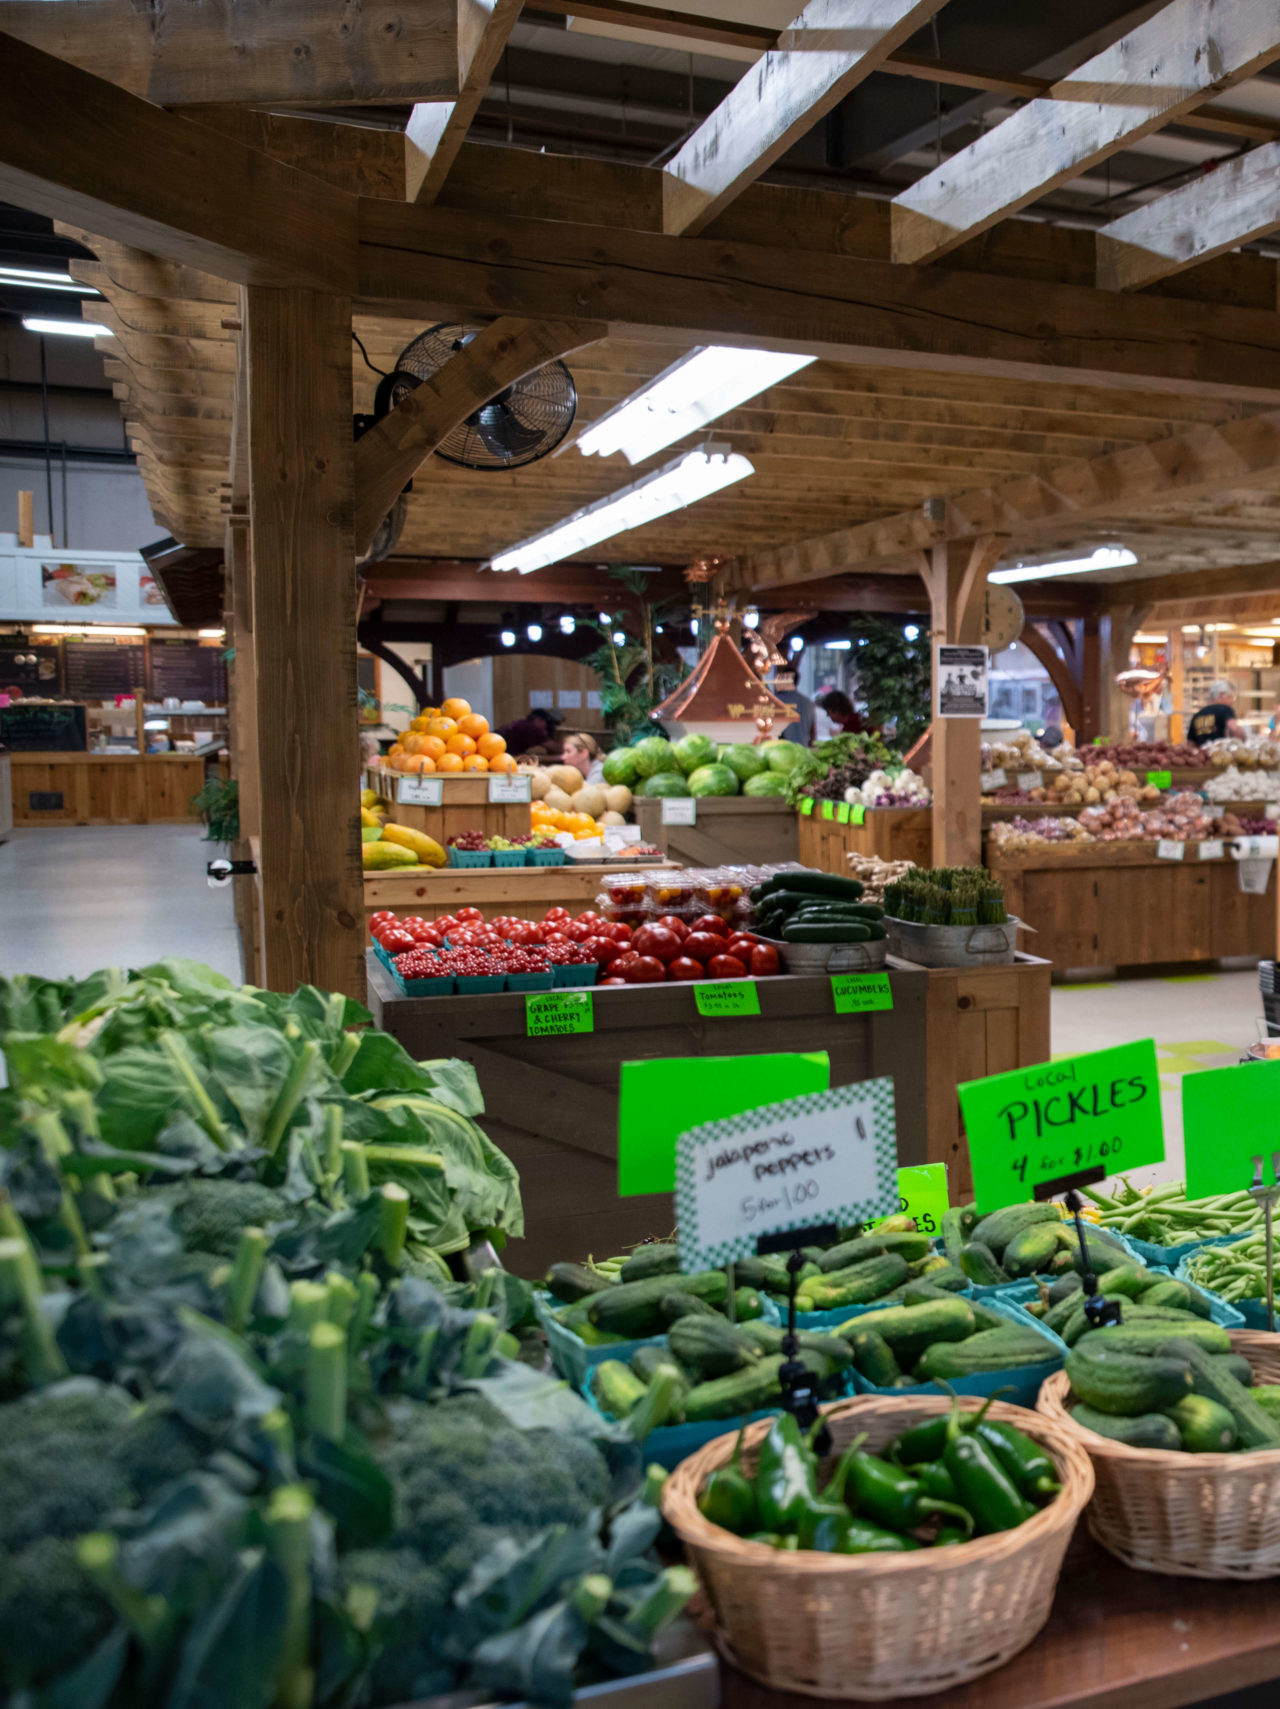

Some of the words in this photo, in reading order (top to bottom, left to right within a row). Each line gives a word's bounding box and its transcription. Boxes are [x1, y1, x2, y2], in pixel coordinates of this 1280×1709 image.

[835, 984, 890, 997] CUCUMBERS
[529, 1003, 560, 1014] GRAPE
[534, 1013, 544, 1025] &
[544, 1012, 580, 1024] CHERRY
[528, 1023, 575, 1036] TOMATOES
[998, 1075, 1148, 1140] PICKLES
[754, 1144, 836, 1181] peppers
[1012, 1155, 1028, 1183] 4
[1041, 1156, 1065, 1171] for
[1074, 1136, 1123, 1167] $1.00
